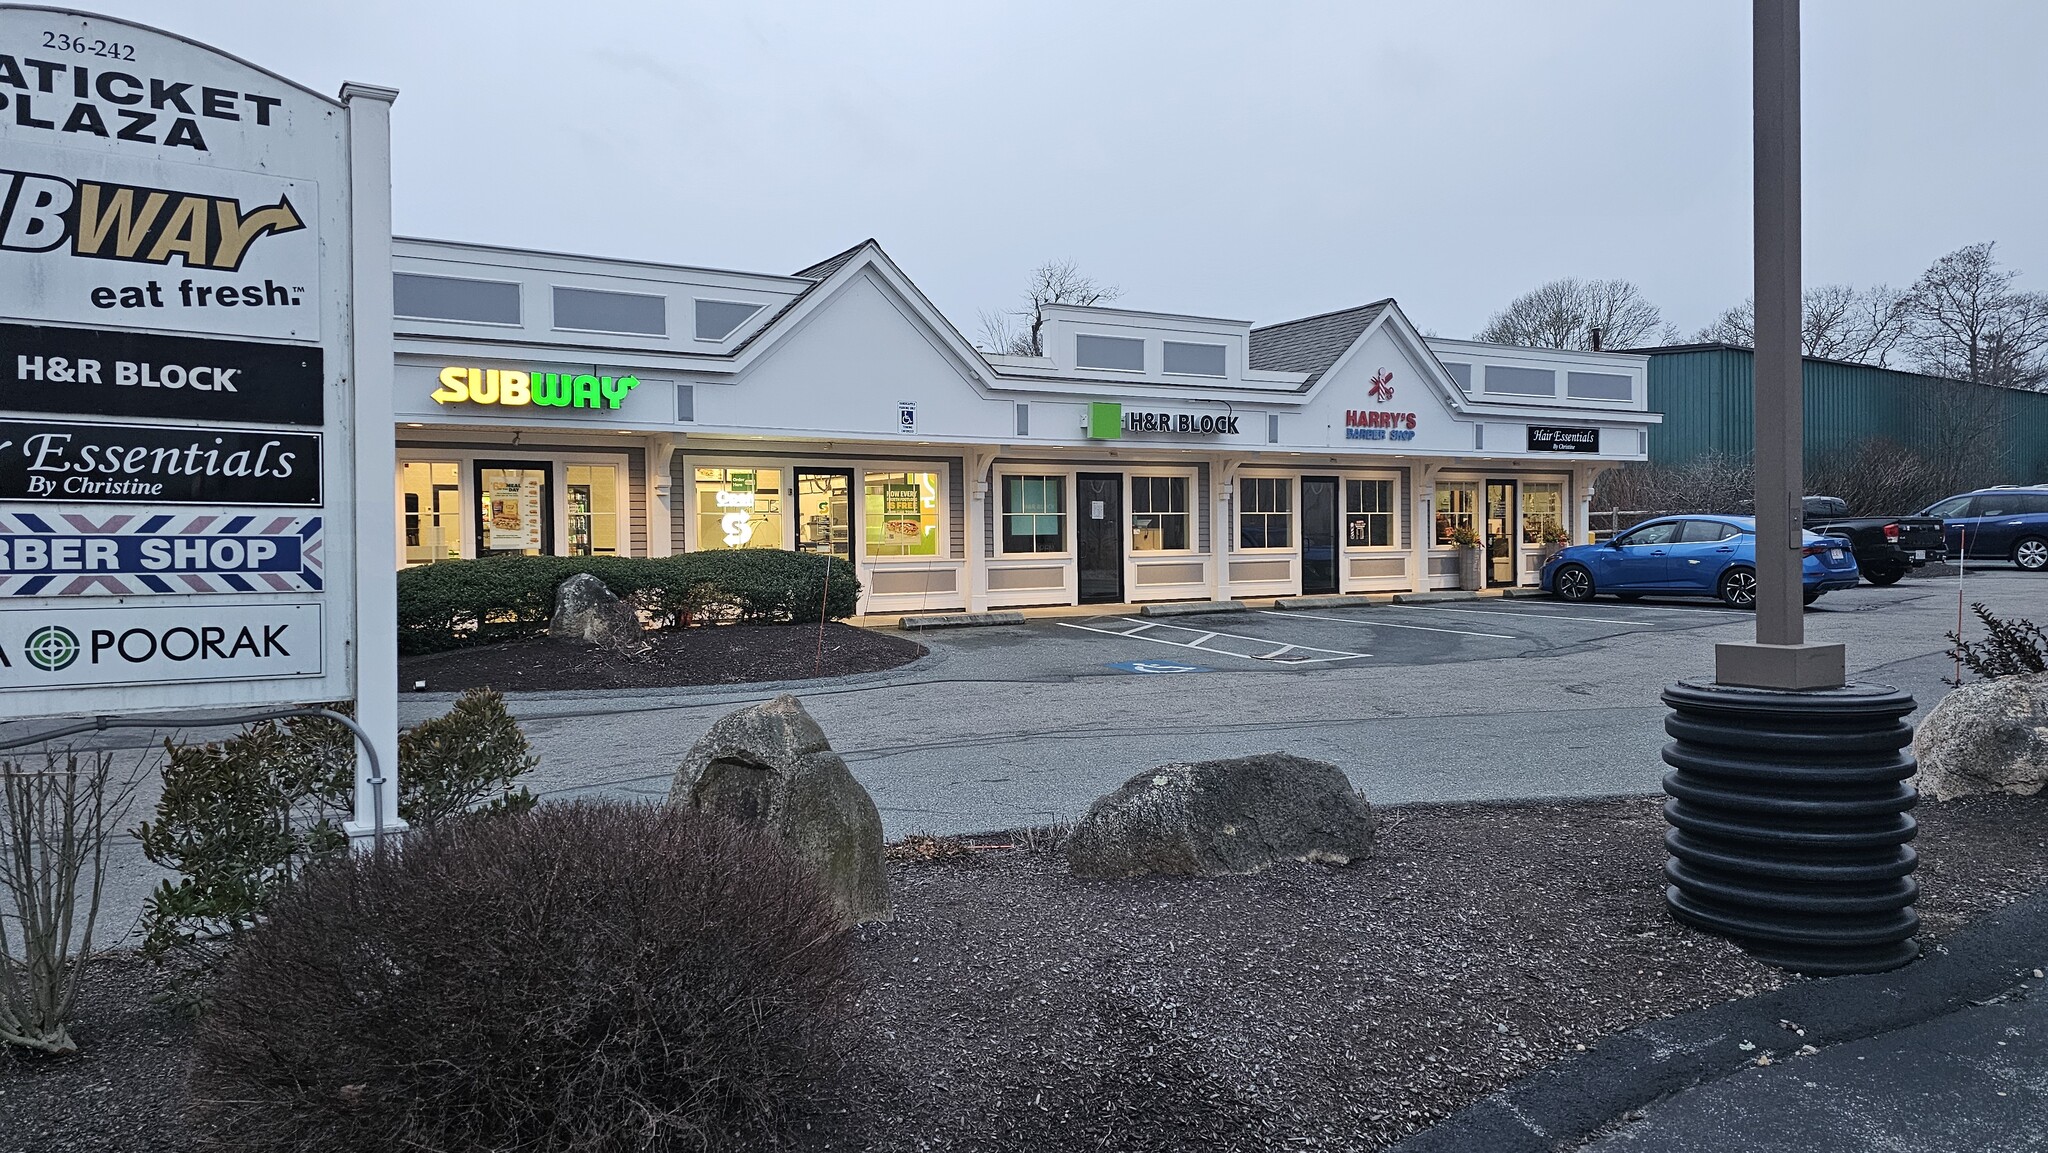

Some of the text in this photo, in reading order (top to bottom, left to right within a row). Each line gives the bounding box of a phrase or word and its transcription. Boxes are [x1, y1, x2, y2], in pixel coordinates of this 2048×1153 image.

[42, 31, 136, 62] 236-242
[0, 91, 209, 151] LAZA
[0, 168, 306, 272] BWAY
[90, 281, 164, 309] eat
[17, 355, 103, 385] H&R
[431, 366, 641, 409] SUBWAY
[1130, 411, 1240, 434] H&R BLOCK
[1345, 409, 1417, 430] HARRY'S
[1346, 427, 1416, 441] BARBER SHOP
[1533, 429, 1595, 443] Hair Essentials
[1552, 443, 1559, 451] By
[23, 433, 296, 478] Essentials
[27, 475, 163, 497] By Christine
[140, 538, 277, 570] SHOP
[91, 624, 291, 664] POORAK
